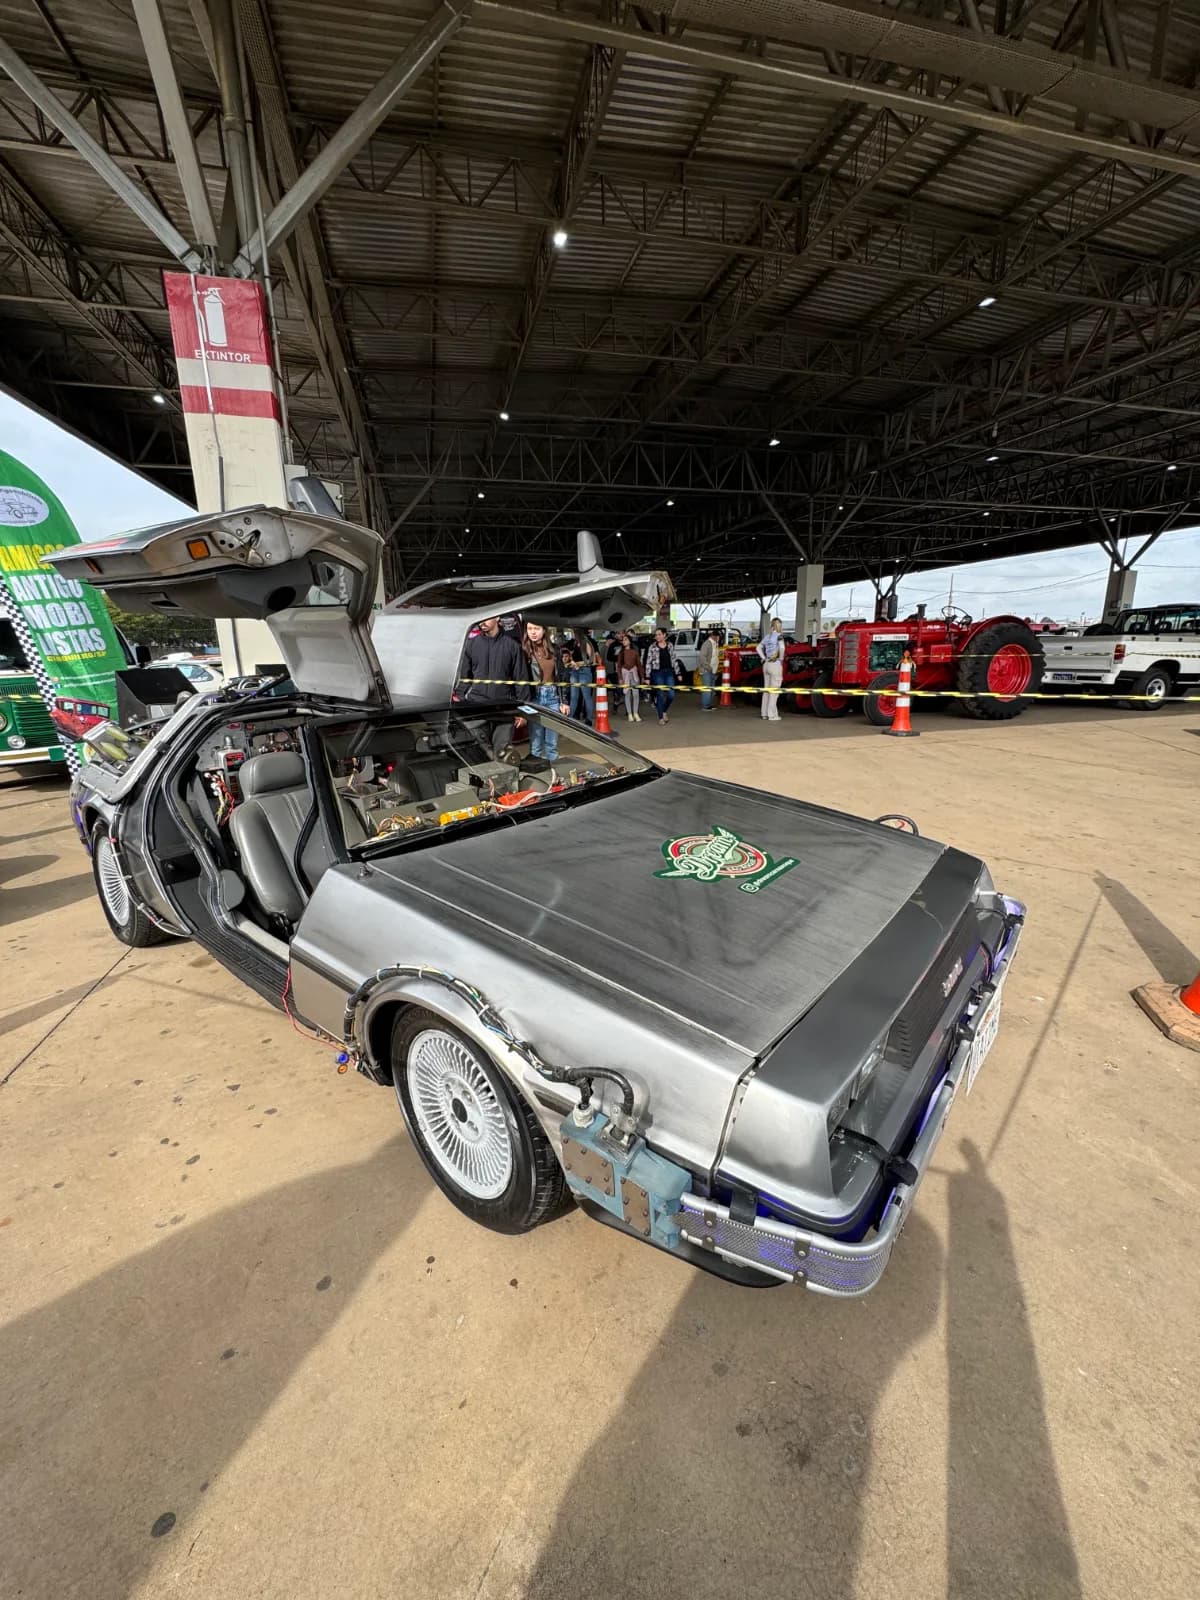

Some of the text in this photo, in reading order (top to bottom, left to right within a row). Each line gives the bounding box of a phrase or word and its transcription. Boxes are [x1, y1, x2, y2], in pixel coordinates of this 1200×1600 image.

[194, 349, 252, 363] EXTINTOR
[21, 601, 95, 629] MOBI
[36, 628, 106, 656] LISTAS
